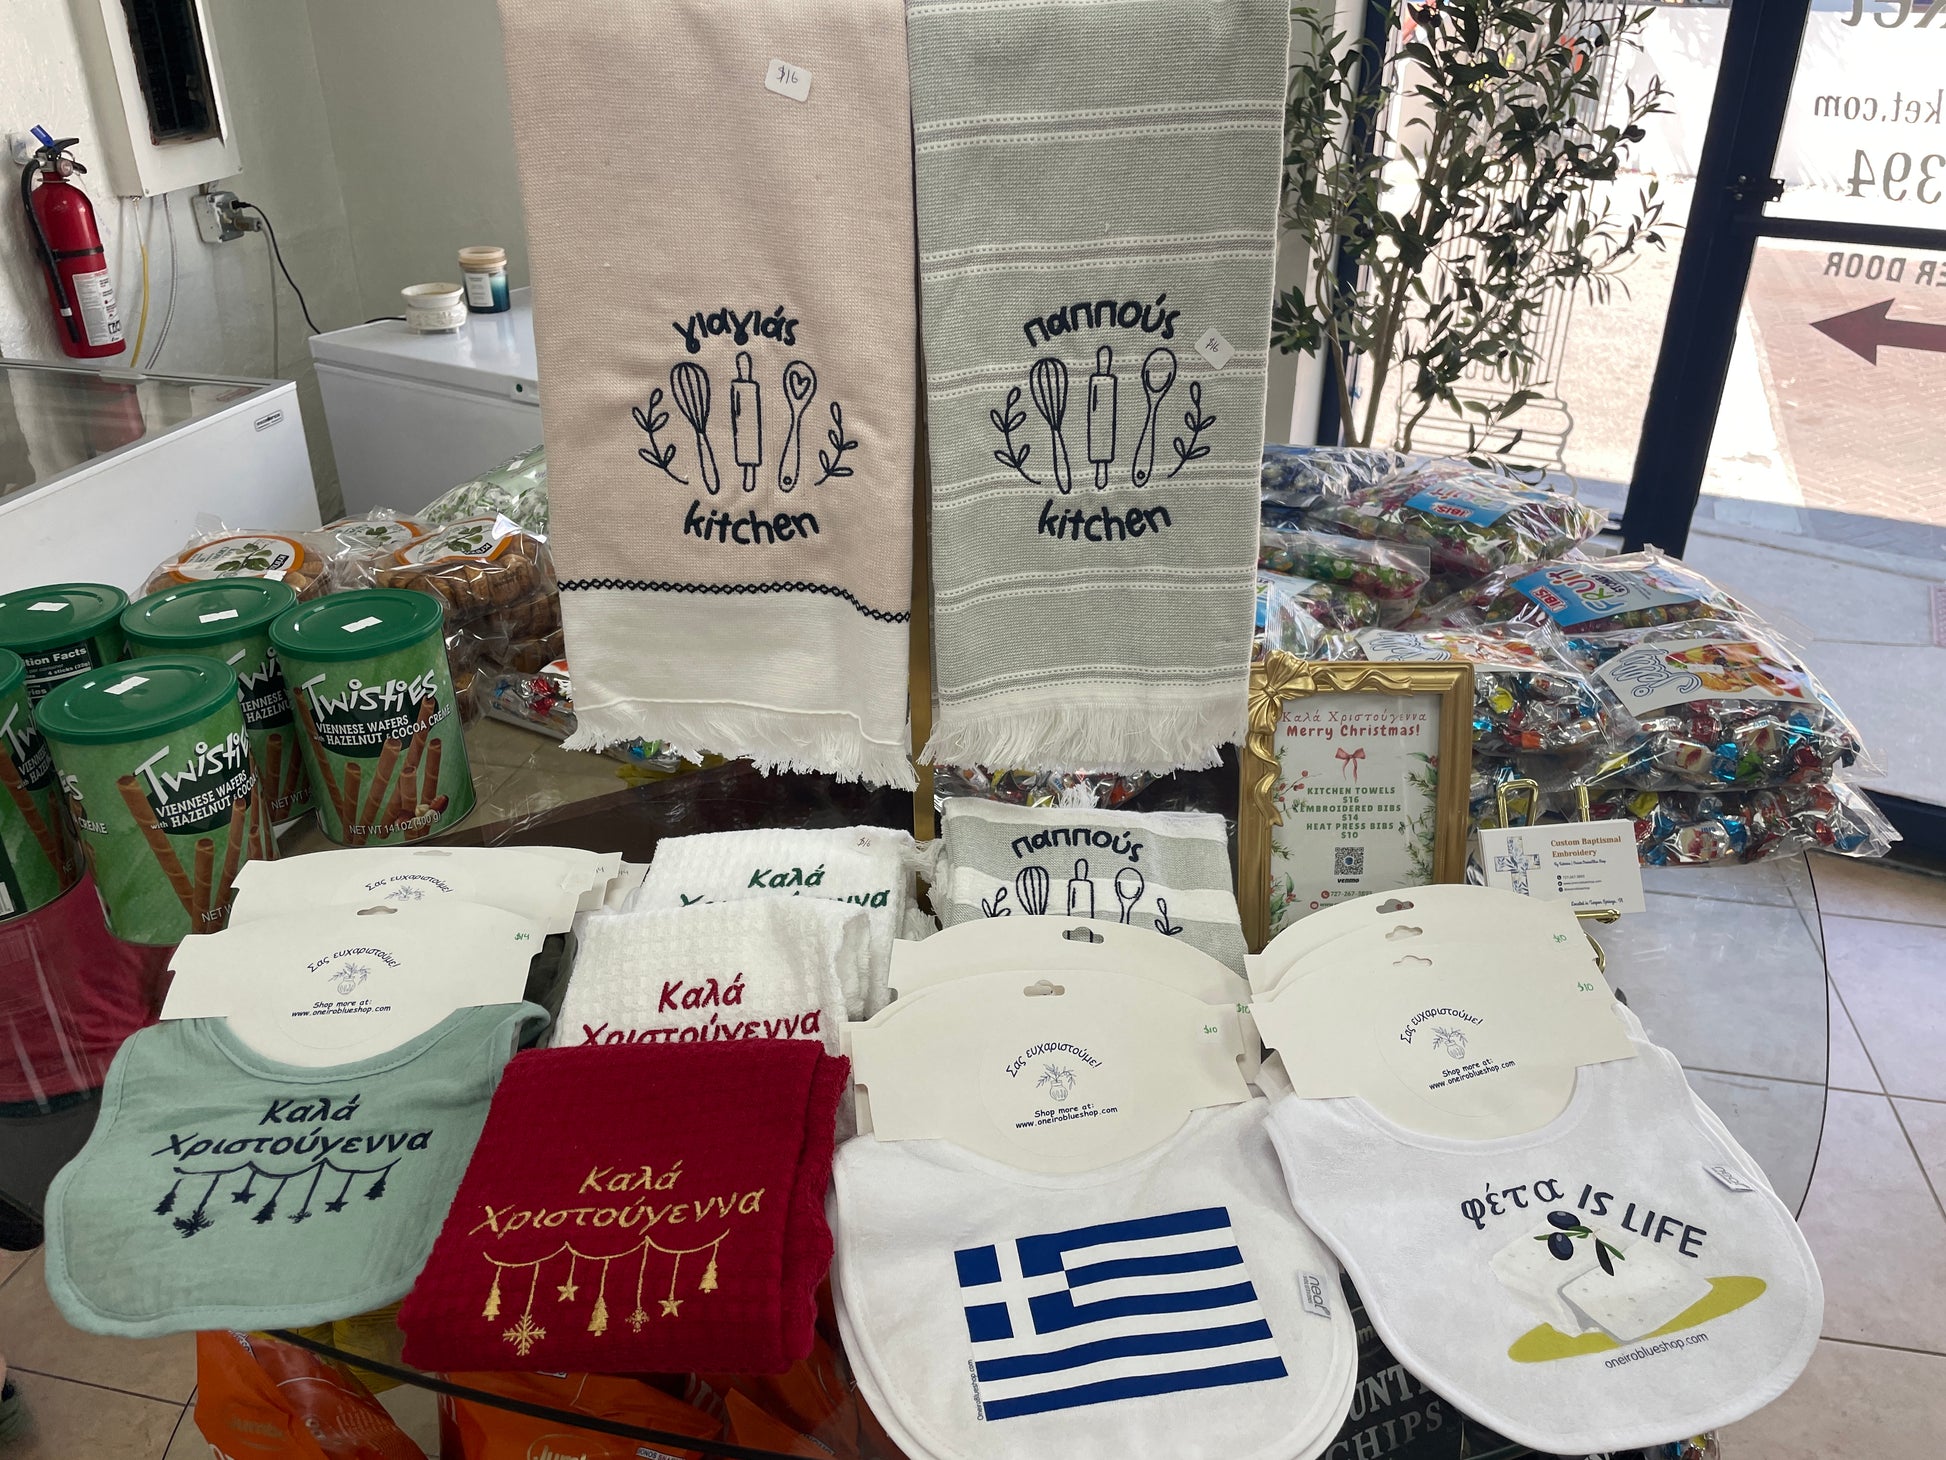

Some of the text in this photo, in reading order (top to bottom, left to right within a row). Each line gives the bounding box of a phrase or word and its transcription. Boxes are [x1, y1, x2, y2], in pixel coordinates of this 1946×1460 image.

[776, 65, 799, 84] $16
[672, 304, 800, 354] γιαγιάς
[1023, 293, 1181, 347] παππούς
[684, 499, 820, 545] kitchen
[1038, 499, 1172, 541] kitchen
[52, 647, 87, 662] Facts
[241, 690, 284, 713] IENNESE
[316, 714, 409, 734] VIENNESE WAFERS
[327, 733, 383, 746] HAZELNUT
[392, 719, 427, 741] COCOA
[1287, 724, 1420, 741] Merry Christmas!
[156, 770, 247, 818] VIENNESE WAFERS
[1307, 786, 1395, 795] KITCHEN TOWELS
[172, 798, 232, 828] HAZELNUT
[1300, 804, 1401, 813] EMBROIDERED BIBS
[350, 824, 366, 835] NET
[368, 823, 382, 834] WT
[1306, 822, 1394, 831] HEAT PRESS BIBS
[1341, 831, 1359, 839] $10
[1011, 828, 1143, 862] παππούς
[1550, 836, 1621, 847] Custom Baptismal
[1552, 849, 1597, 857] Embroidery
[364, 877, 387, 892] Σας
[748, 863, 825, 889] Καλά
[201, 906, 222, 923] NET
[307, 946, 402, 974] Σας ευχαριστούμε!
[658, 972, 746, 1013] Καλά
[1577, 981, 1594, 992] $10
[291, 1005, 392, 1018] www.oneiroblueshop.com
[312, 1000, 334, 1009] Shop
[336, 1000, 357, 1008] more
[1203, 1025, 1218, 1035] $10
[1400, 1007, 1484, 1044] Σας ευχαριστούμε!
[1005, 1041, 1103, 1078] Σας ευχαριστούμε!
[1442, 1067, 1461, 1078] Shop
[1462, 1063, 1480, 1073] more
[1429, 1059, 1516, 1090] www.oneiroblueshop.com
[258, 1093, 361, 1126] Καλά
[1015, 1106, 1118, 1130] www.oneiroblueshop.com
[1034, 1107, 1056, 1118] Shop
[1058, 1105, 1079, 1114] more
[151, 1126, 434, 1162] Χριστούγεννα
[578, 1159, 684, 1193] Καλά
[468, 1187, 766, 1239] Χριστούγεννα
[1460, 1178, 1708, 1258] φέτα IS LIFE
[1604, 1331, 1710, 1370] oneiroblueshop.com
